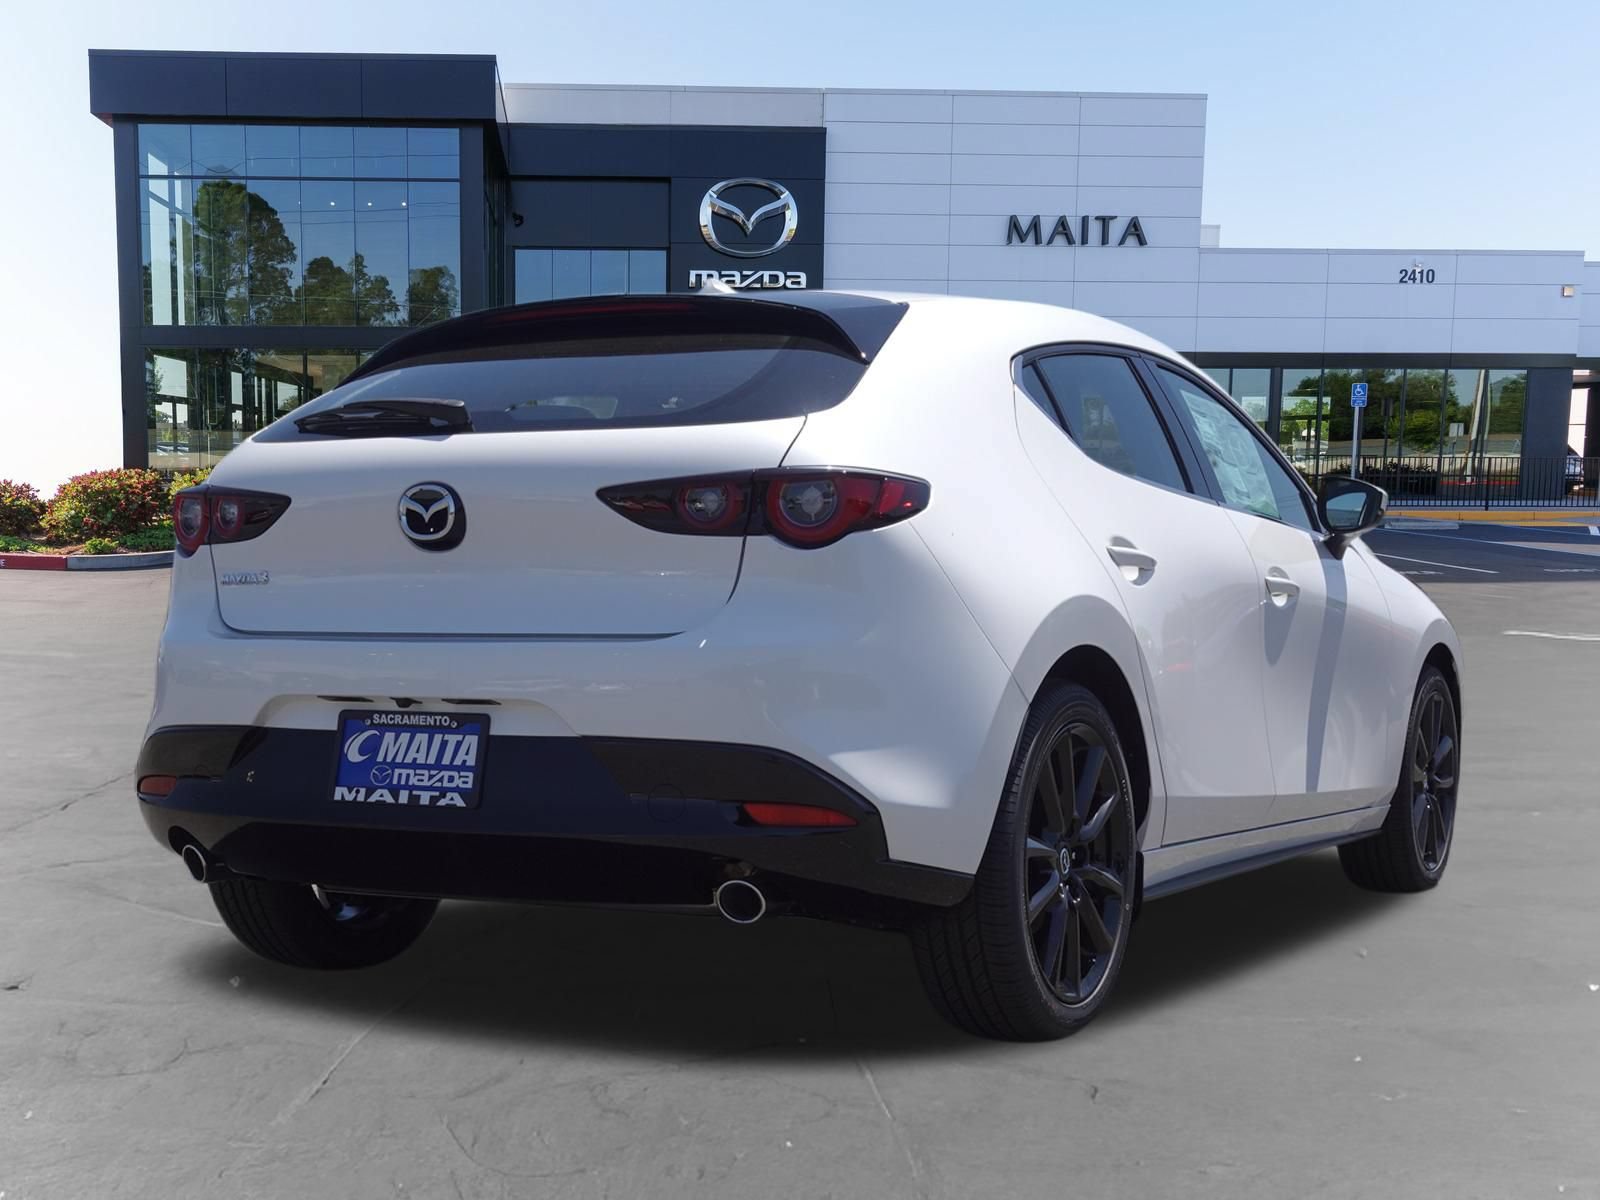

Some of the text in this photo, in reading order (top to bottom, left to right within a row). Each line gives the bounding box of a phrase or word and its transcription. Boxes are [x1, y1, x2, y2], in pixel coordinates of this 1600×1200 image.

[1006, 214, 1148, 246] MAITA
[1399, 268, 1436, 284] 2410
[373, 713, 450, 727] SACRAMENTO
[376, 732, 479, 767] MAITA
[392, 768, 474, 789] mazda
[333, 786, 467, 808] MAITA
